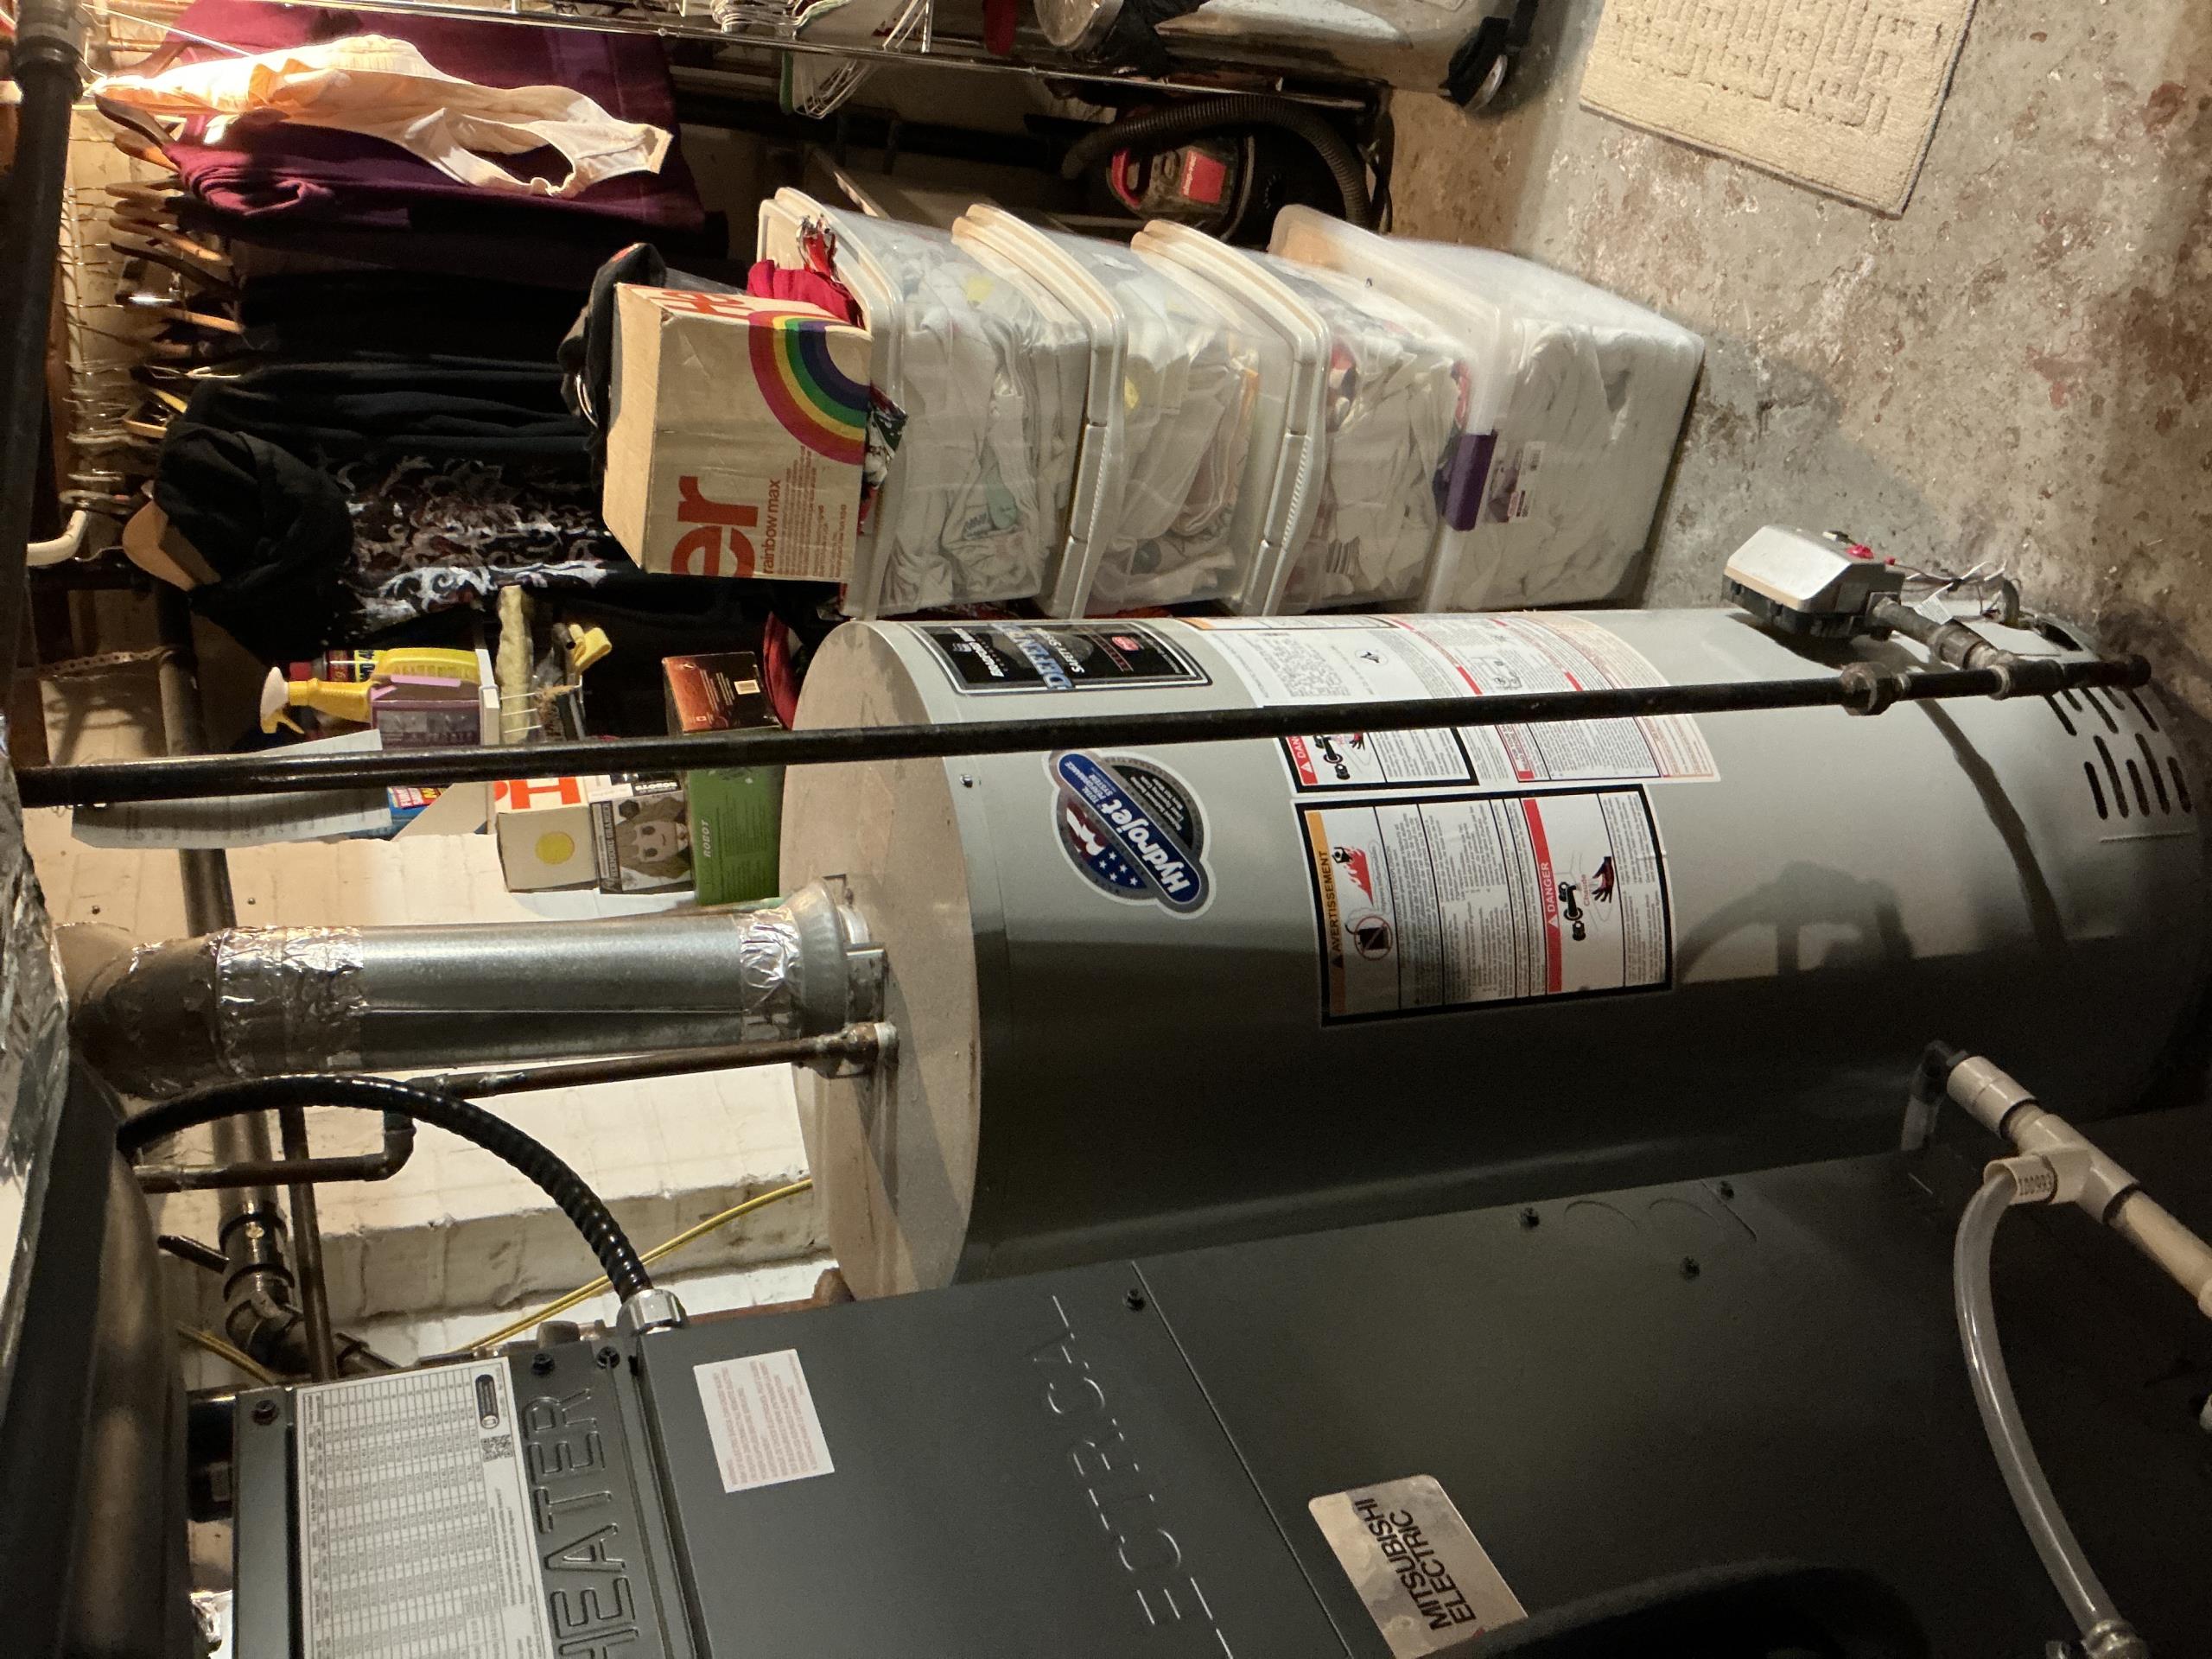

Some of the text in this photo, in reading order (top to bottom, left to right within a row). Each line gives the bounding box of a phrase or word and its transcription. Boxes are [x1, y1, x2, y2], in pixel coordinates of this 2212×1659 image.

[760, 479, 781, 575] rainbow max
[1053, 646, 1085, 673] SAFETY
[1291, 736, 1306, 759] DAN
[1065, 760, 1107, 799] PERFORMANCE
[1082, 785, 1099, 803] TOTAL
[1089, 773, 1113, 796] SYSTEM
[701, 818, 711, 857] ROBOT
[1100, 798, 1192, 893] Hydrojet
[1319, 850, 1341, 952] AVERTISSEMENT
[1541, 861, 1556, 912] DANGER
[1580, 874, 1591, 906] Chaude
[1354, 1497, 1452, 1630] MITSUBISHI
[1389, 1509, 1477, 1624] ELECTRIC
